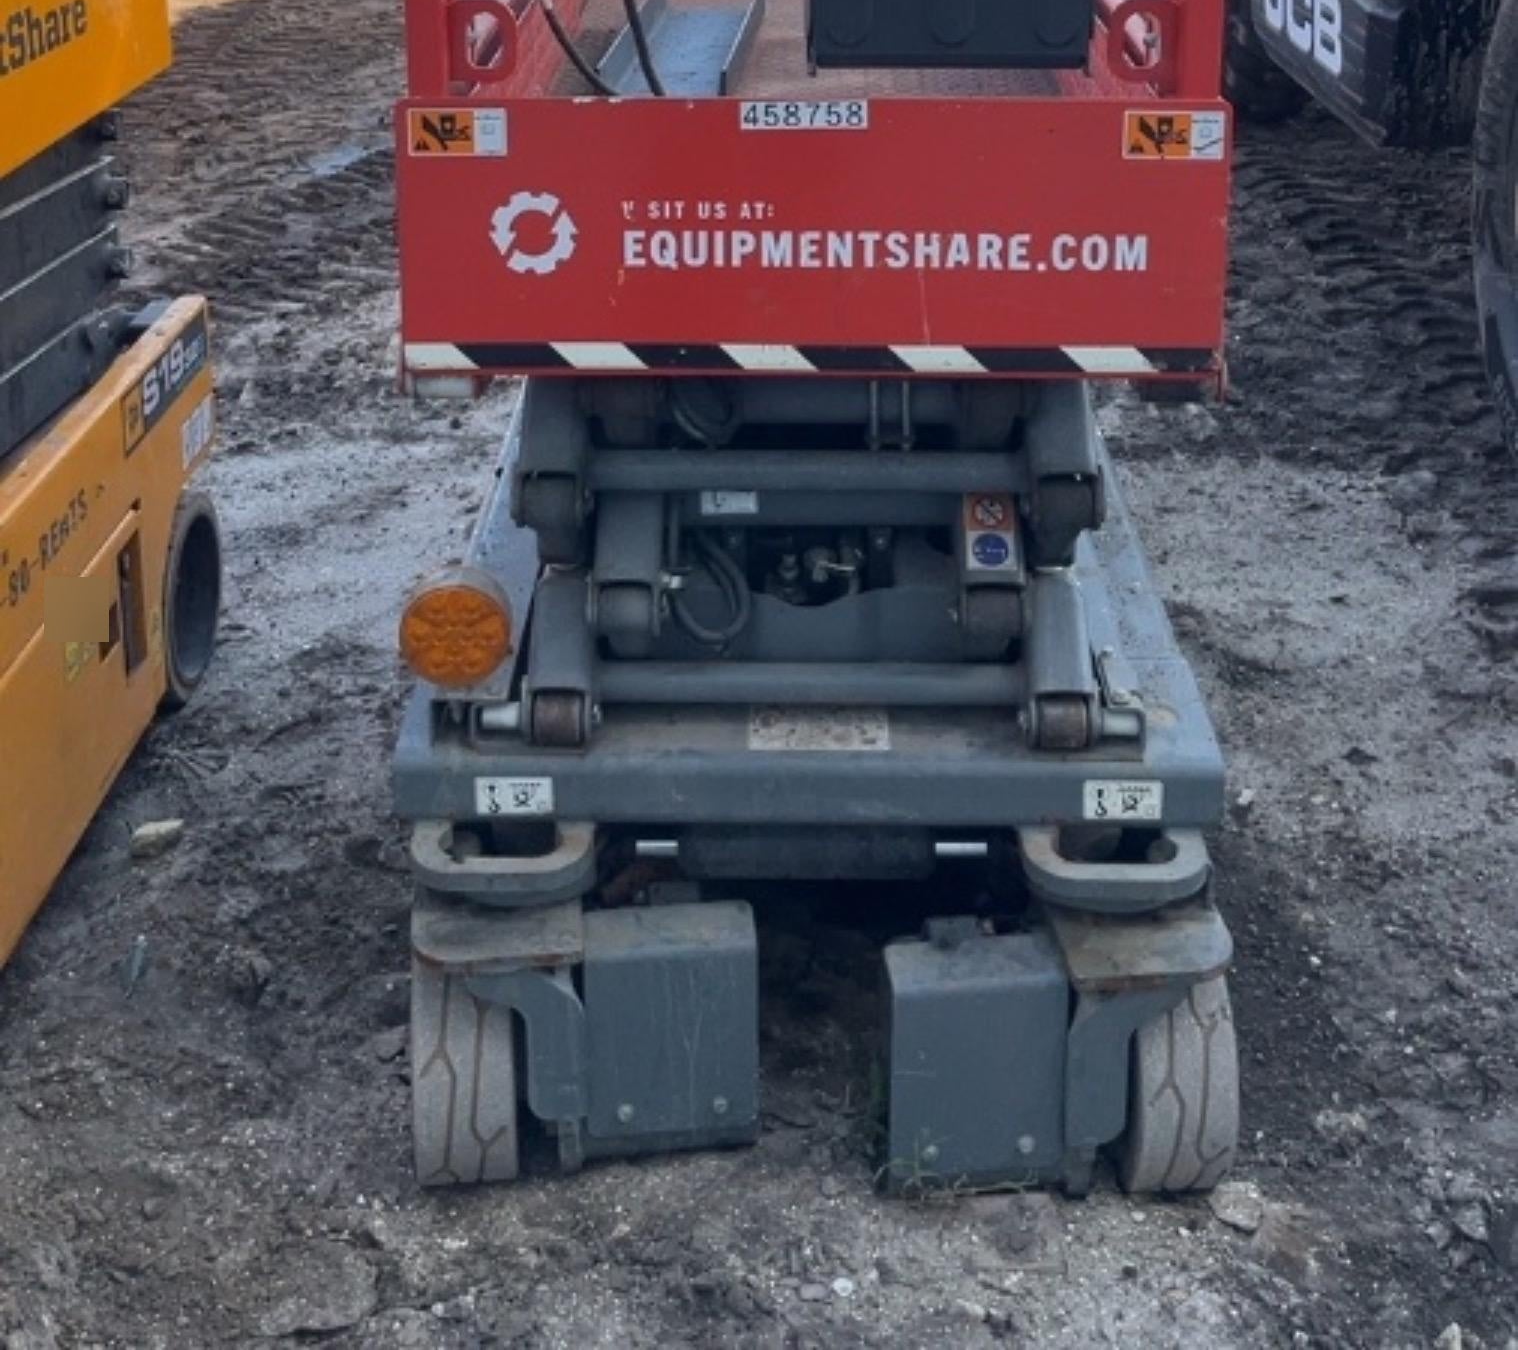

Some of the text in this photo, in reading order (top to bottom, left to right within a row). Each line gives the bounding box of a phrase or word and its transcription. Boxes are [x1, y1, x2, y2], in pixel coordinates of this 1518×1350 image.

[743, 101, 864, 127] 458758
[697, 201, 728, 219] US
[739, 201, 776, 219] AT:
[623, 230, 1149, 271] EQUIPMENTSHARE.COM
